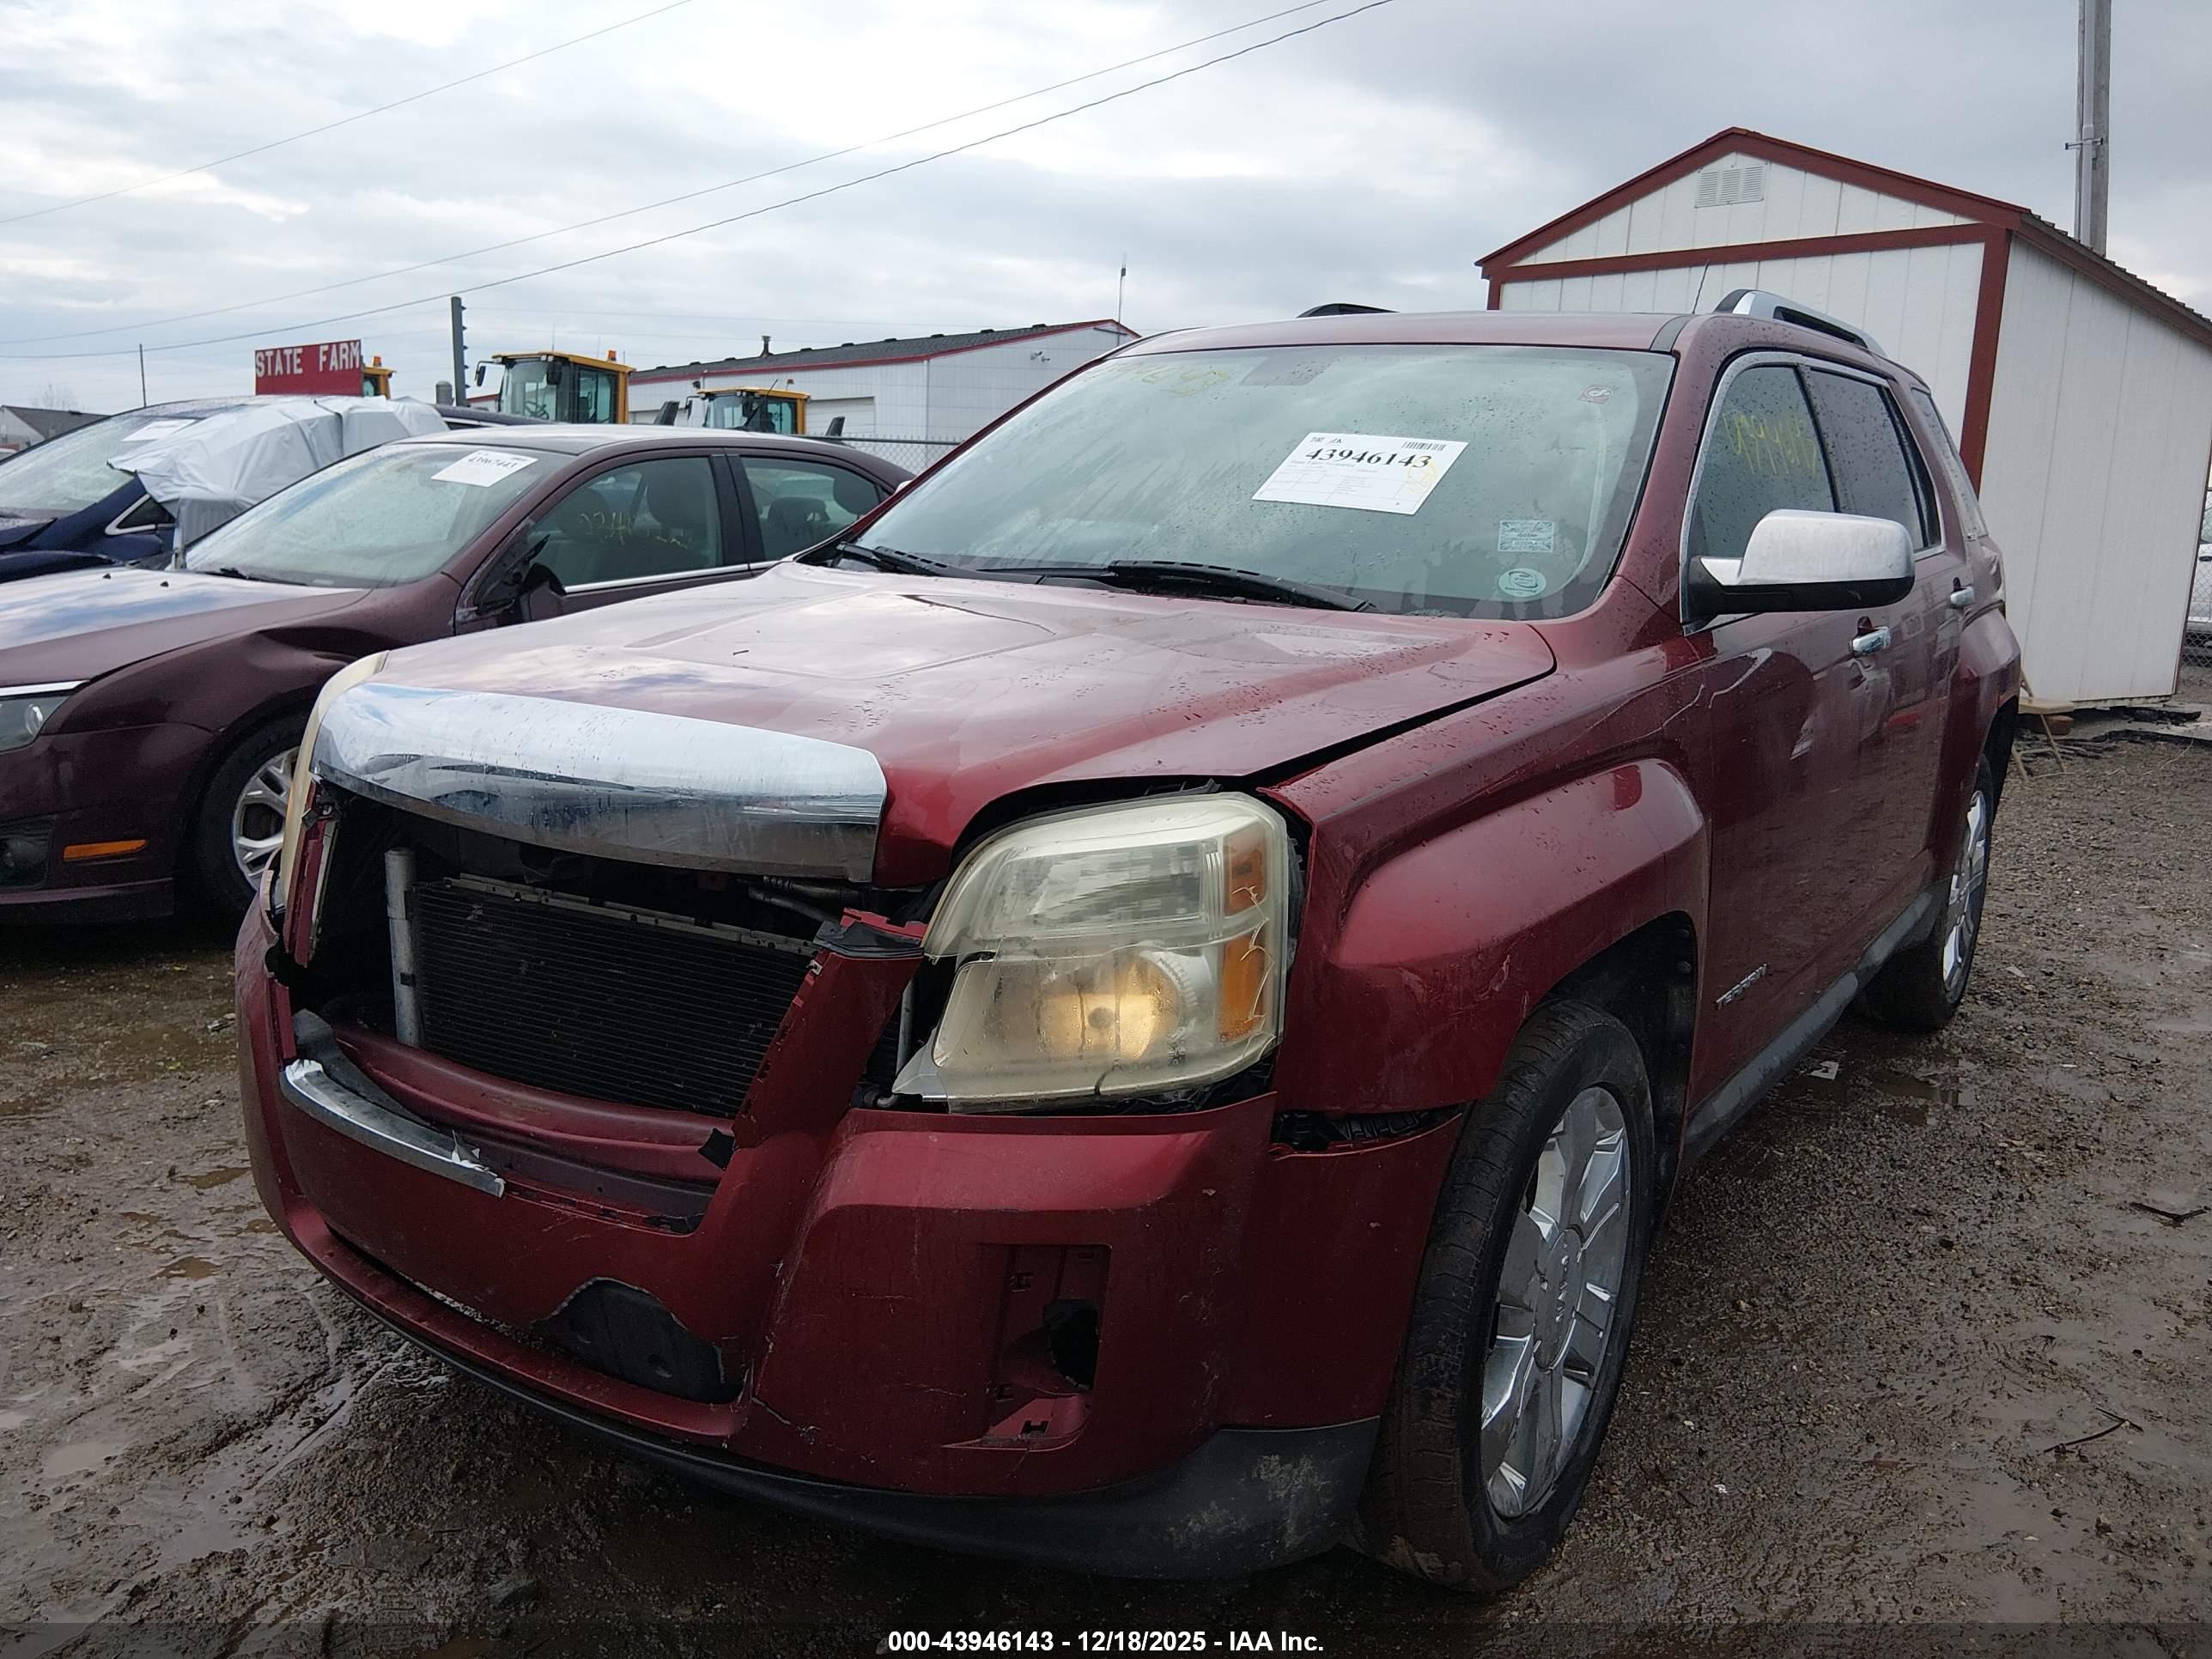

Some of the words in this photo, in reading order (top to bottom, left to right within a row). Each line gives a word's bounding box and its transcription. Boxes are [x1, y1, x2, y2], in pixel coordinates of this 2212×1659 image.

[256, 347, 303, 378] STATE
[319, 341, 360, 372] FARM
[1305, 447, 1432, 469] 43946143
